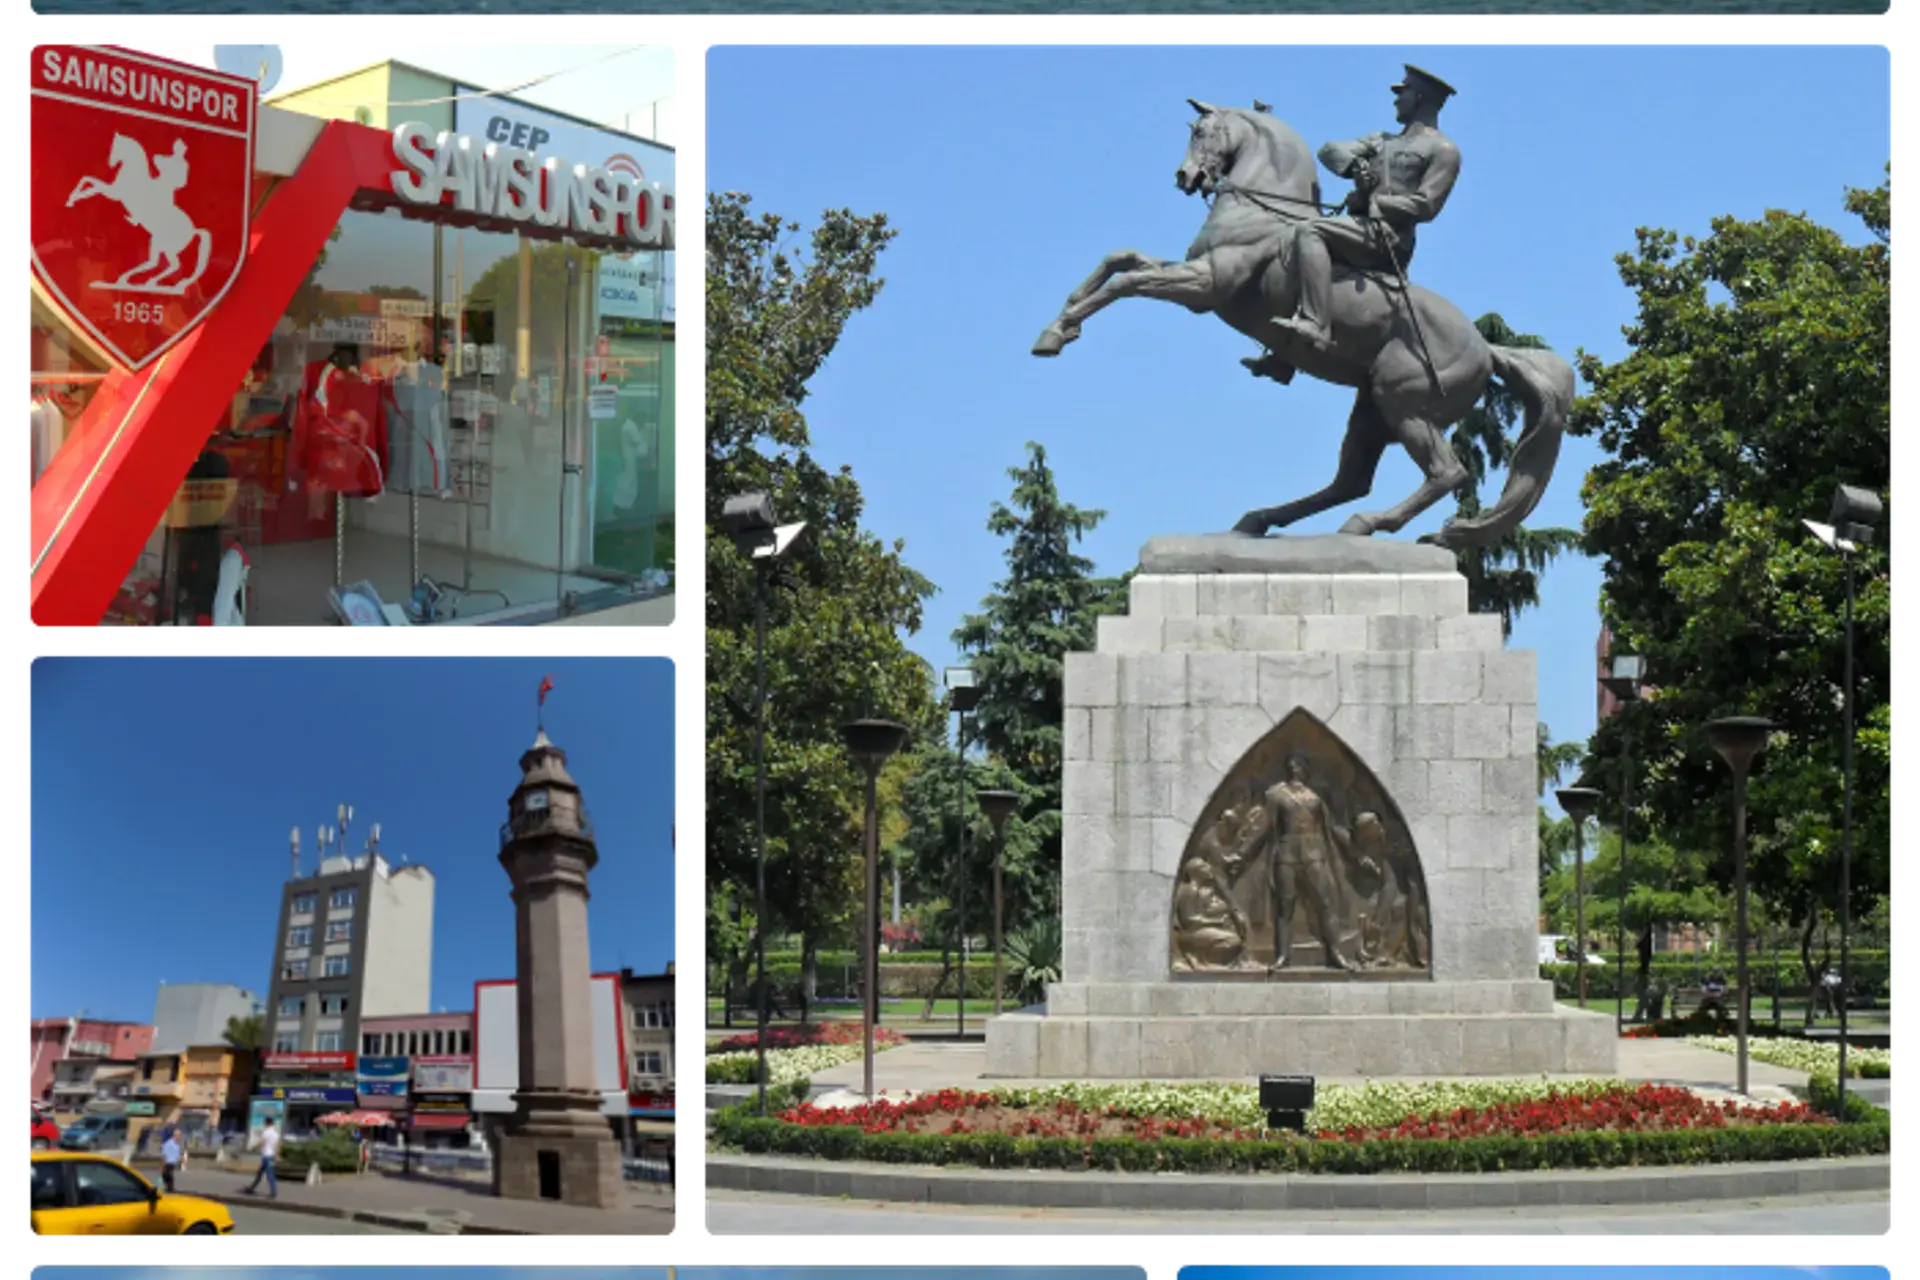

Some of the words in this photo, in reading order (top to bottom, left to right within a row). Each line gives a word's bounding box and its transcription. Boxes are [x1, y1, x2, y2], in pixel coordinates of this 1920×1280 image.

[42, 49, 239, 122] SAMSUNSPOR
[485, 115, 551, 151] CEP
[390, 121, 680, 246] SAMSUNSPOR
[112, 300, 165, 325] 1965
